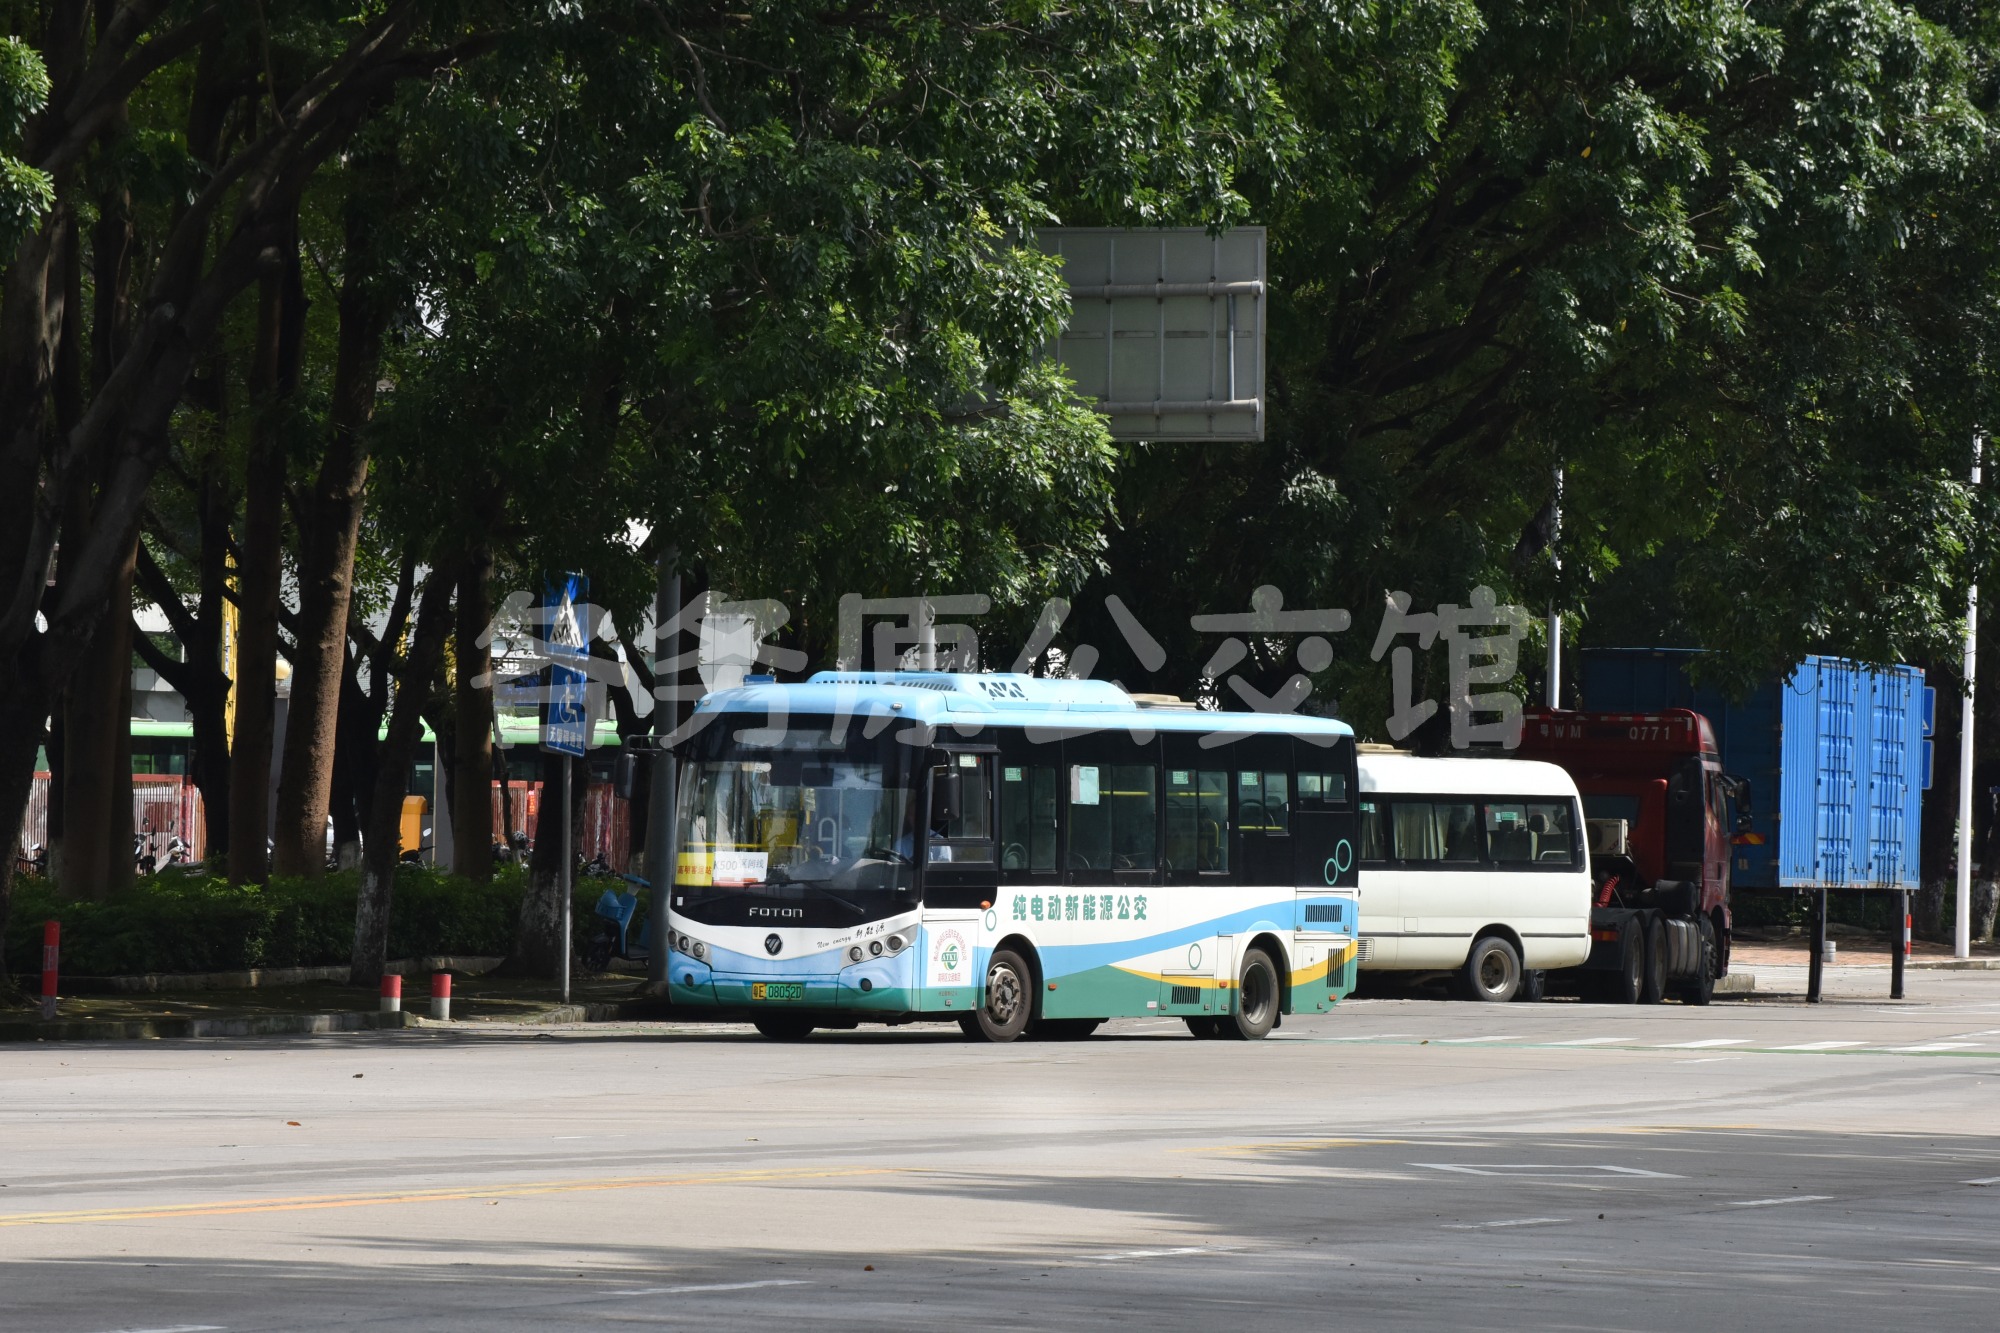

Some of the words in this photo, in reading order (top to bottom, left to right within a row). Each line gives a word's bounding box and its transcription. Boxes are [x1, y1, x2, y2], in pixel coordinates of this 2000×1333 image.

[550, 726, 583, 750] 无障碍通道
[1629, 726, 1670, 741] 0771
[749, 907, 803, 918] FOTON
[1013, 894, 1147, 921] 纯电动新能源公交
